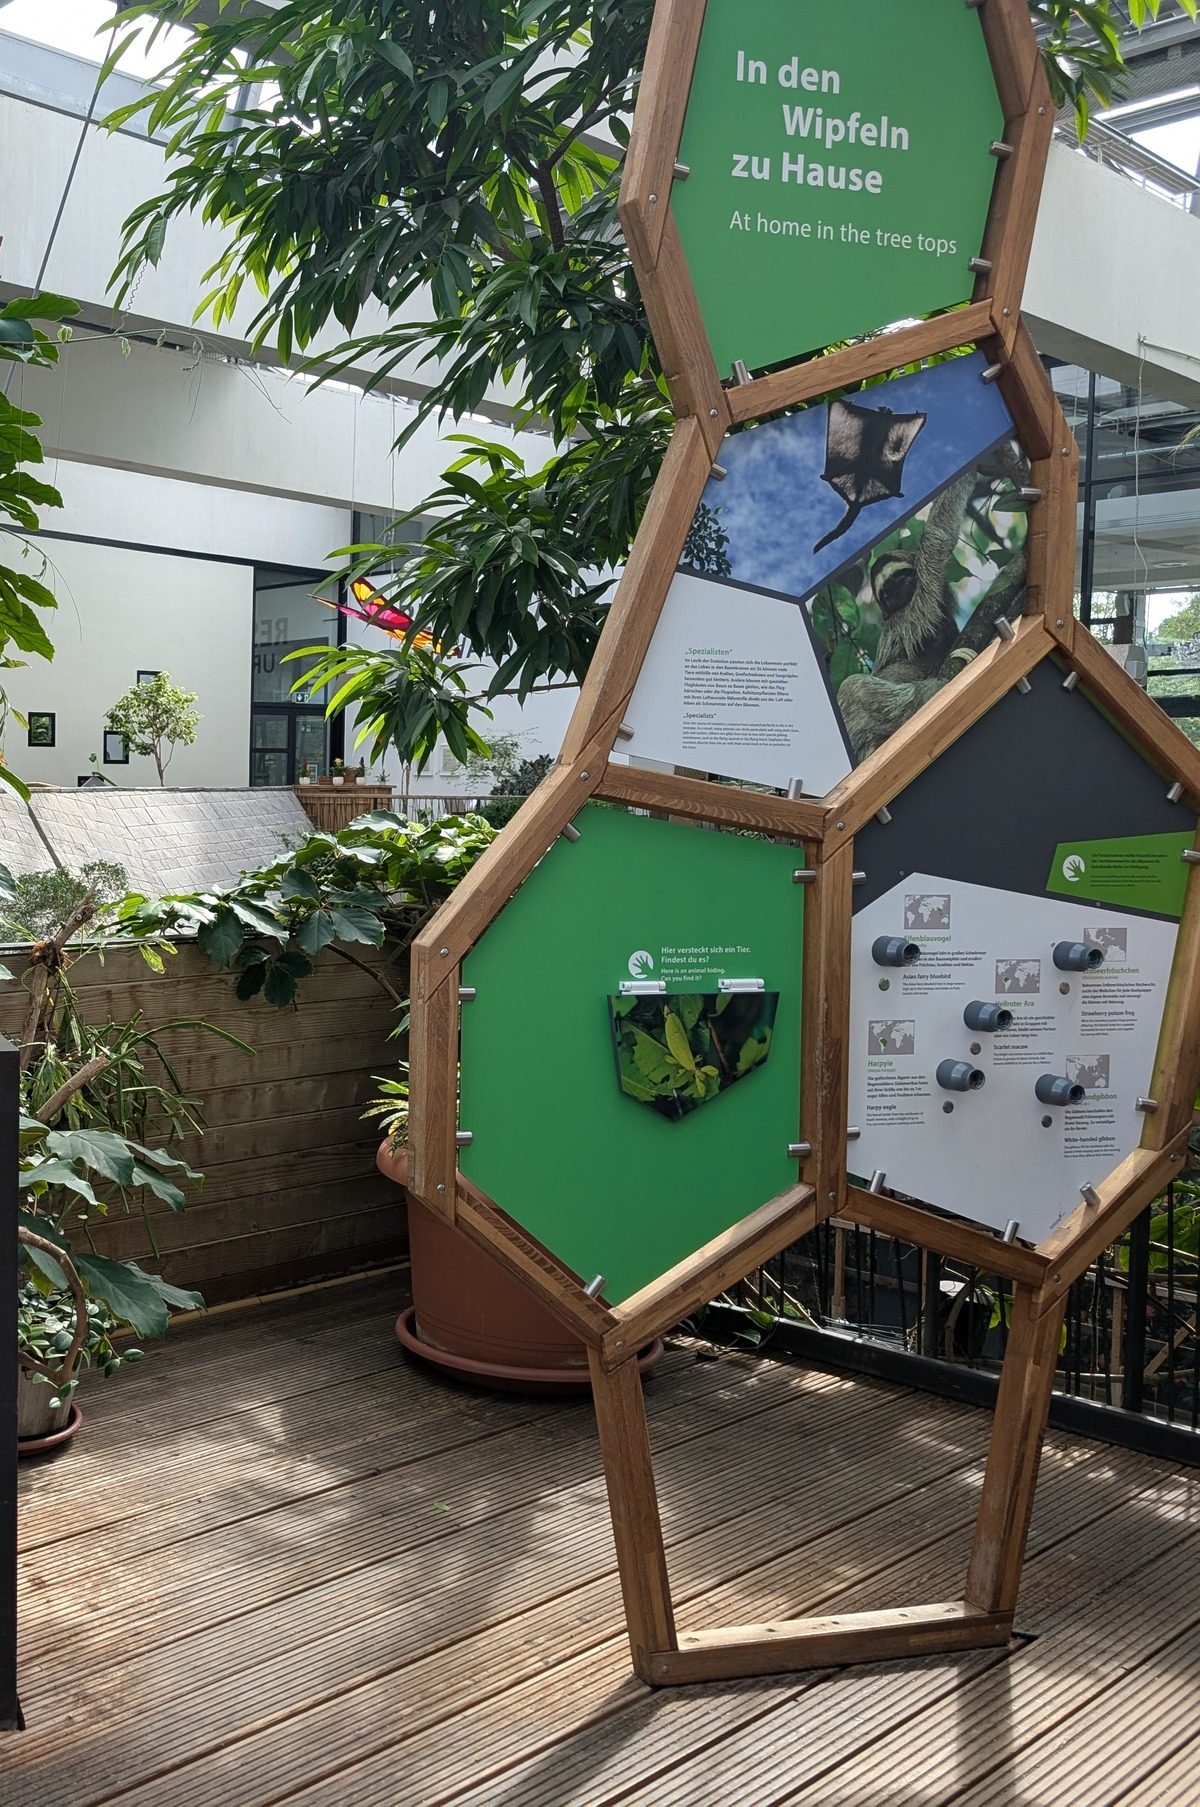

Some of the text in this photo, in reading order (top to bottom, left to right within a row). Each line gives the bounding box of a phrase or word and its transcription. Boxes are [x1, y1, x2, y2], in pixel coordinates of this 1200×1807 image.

[736, 50, 841, 95] In den
[782, 104, 910, 151] Wipfeln
[731, 152, 883, 194] zu Hause
[729, 210, 957, 257] At home in the tree tops
